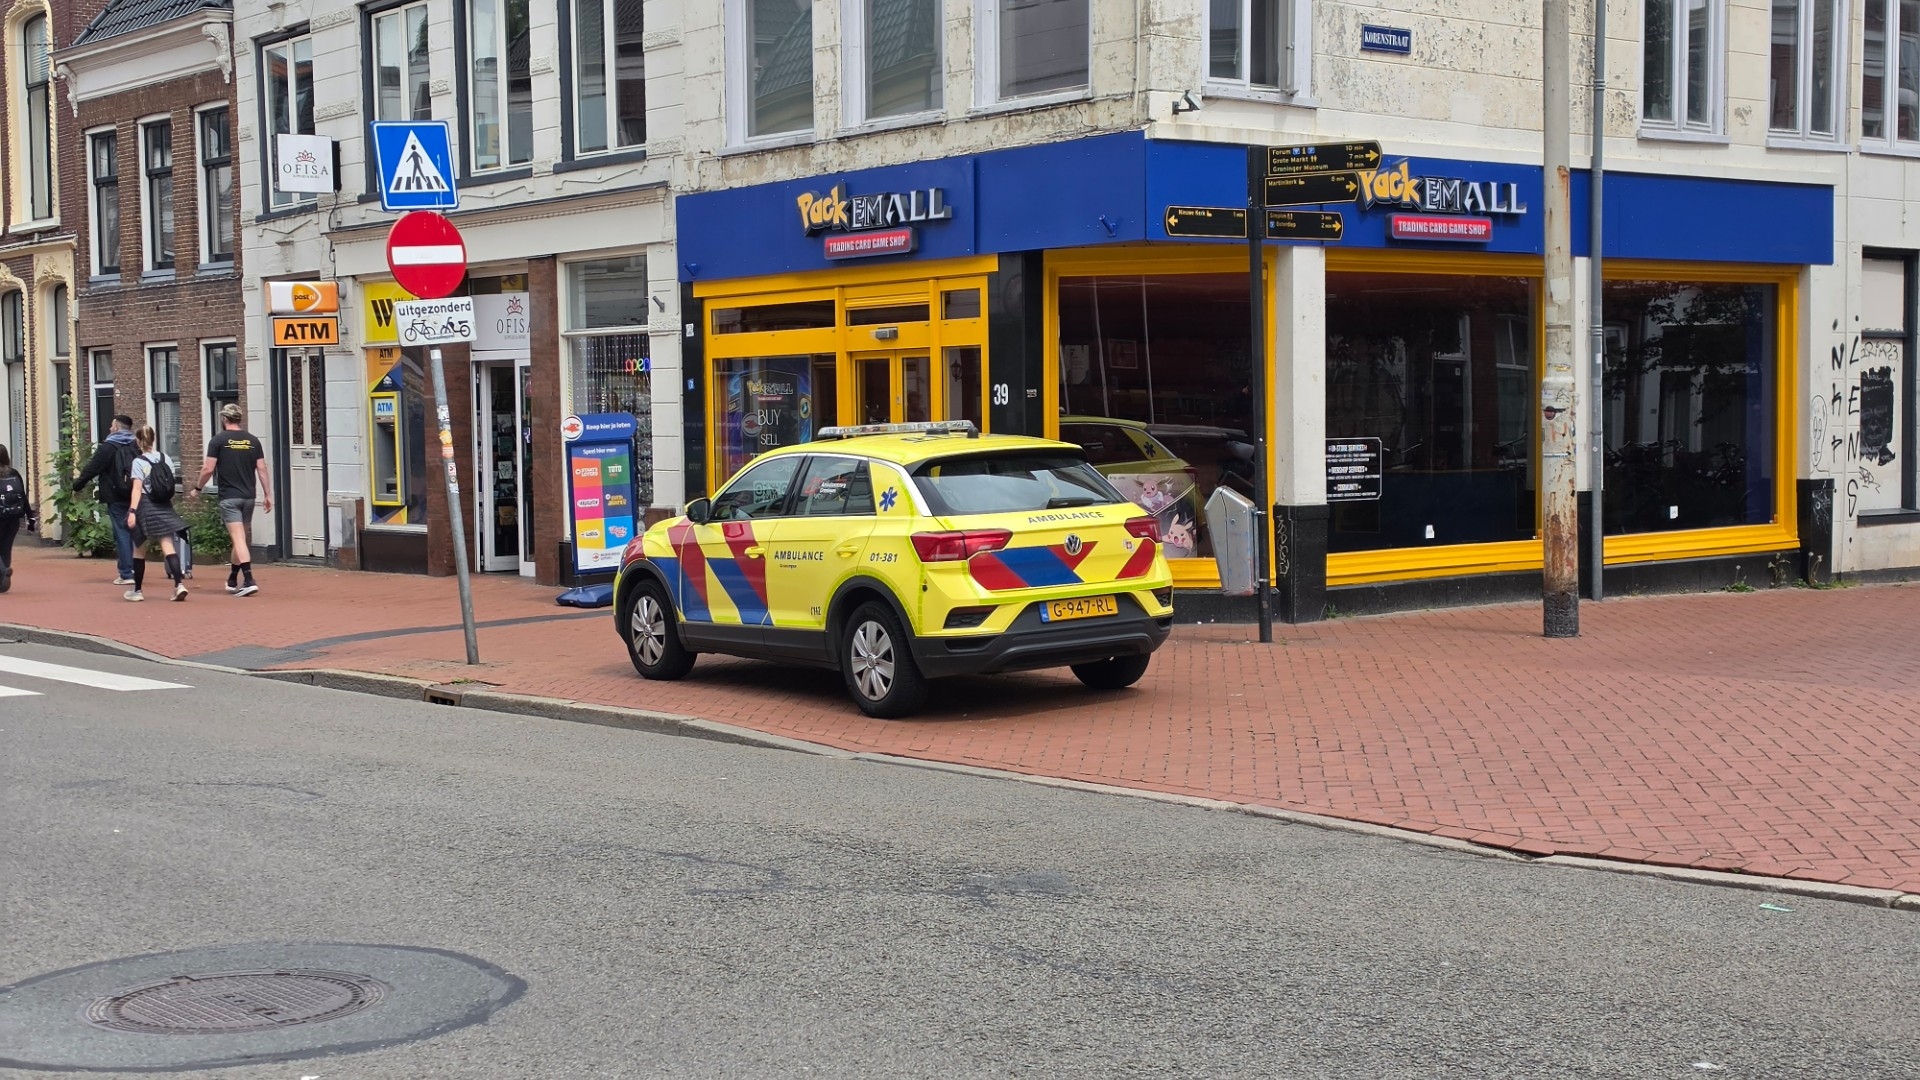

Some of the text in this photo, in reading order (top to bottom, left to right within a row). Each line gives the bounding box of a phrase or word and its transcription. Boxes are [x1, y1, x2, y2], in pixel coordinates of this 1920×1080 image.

[1364, 31, 1409, 47] KORENSTRAAT
[282, 163, 328, 175] OFISA
[1358, 161, 1421, 207] Pack
[797, 184, 849, 231] Pack
[1398, 220, 1487, 236] TRADING CARD GAME SHOP
[829, 235, 906, 253] TRADING CARD GAME SHOP
[398, 301, 472, 318] uitgezonderd
[283, 322, 331, 340] ATM
[379, 347, 394, 359] ATM
[625, 357, 651, 375] open
[993, 383, 1009, 406] 39
[377, 402, 393, 412] ATM
[757, 409, 781, 426] BUY
[760, 433, 780, 446] SELL
[1027, 511, 1105, 524] AMBULANCE
[774, 550, 824, 561] AMBULANCE
[870, 552, 898, 562] 01-381
[1053, 598, 1113, 617] G-947-RL
